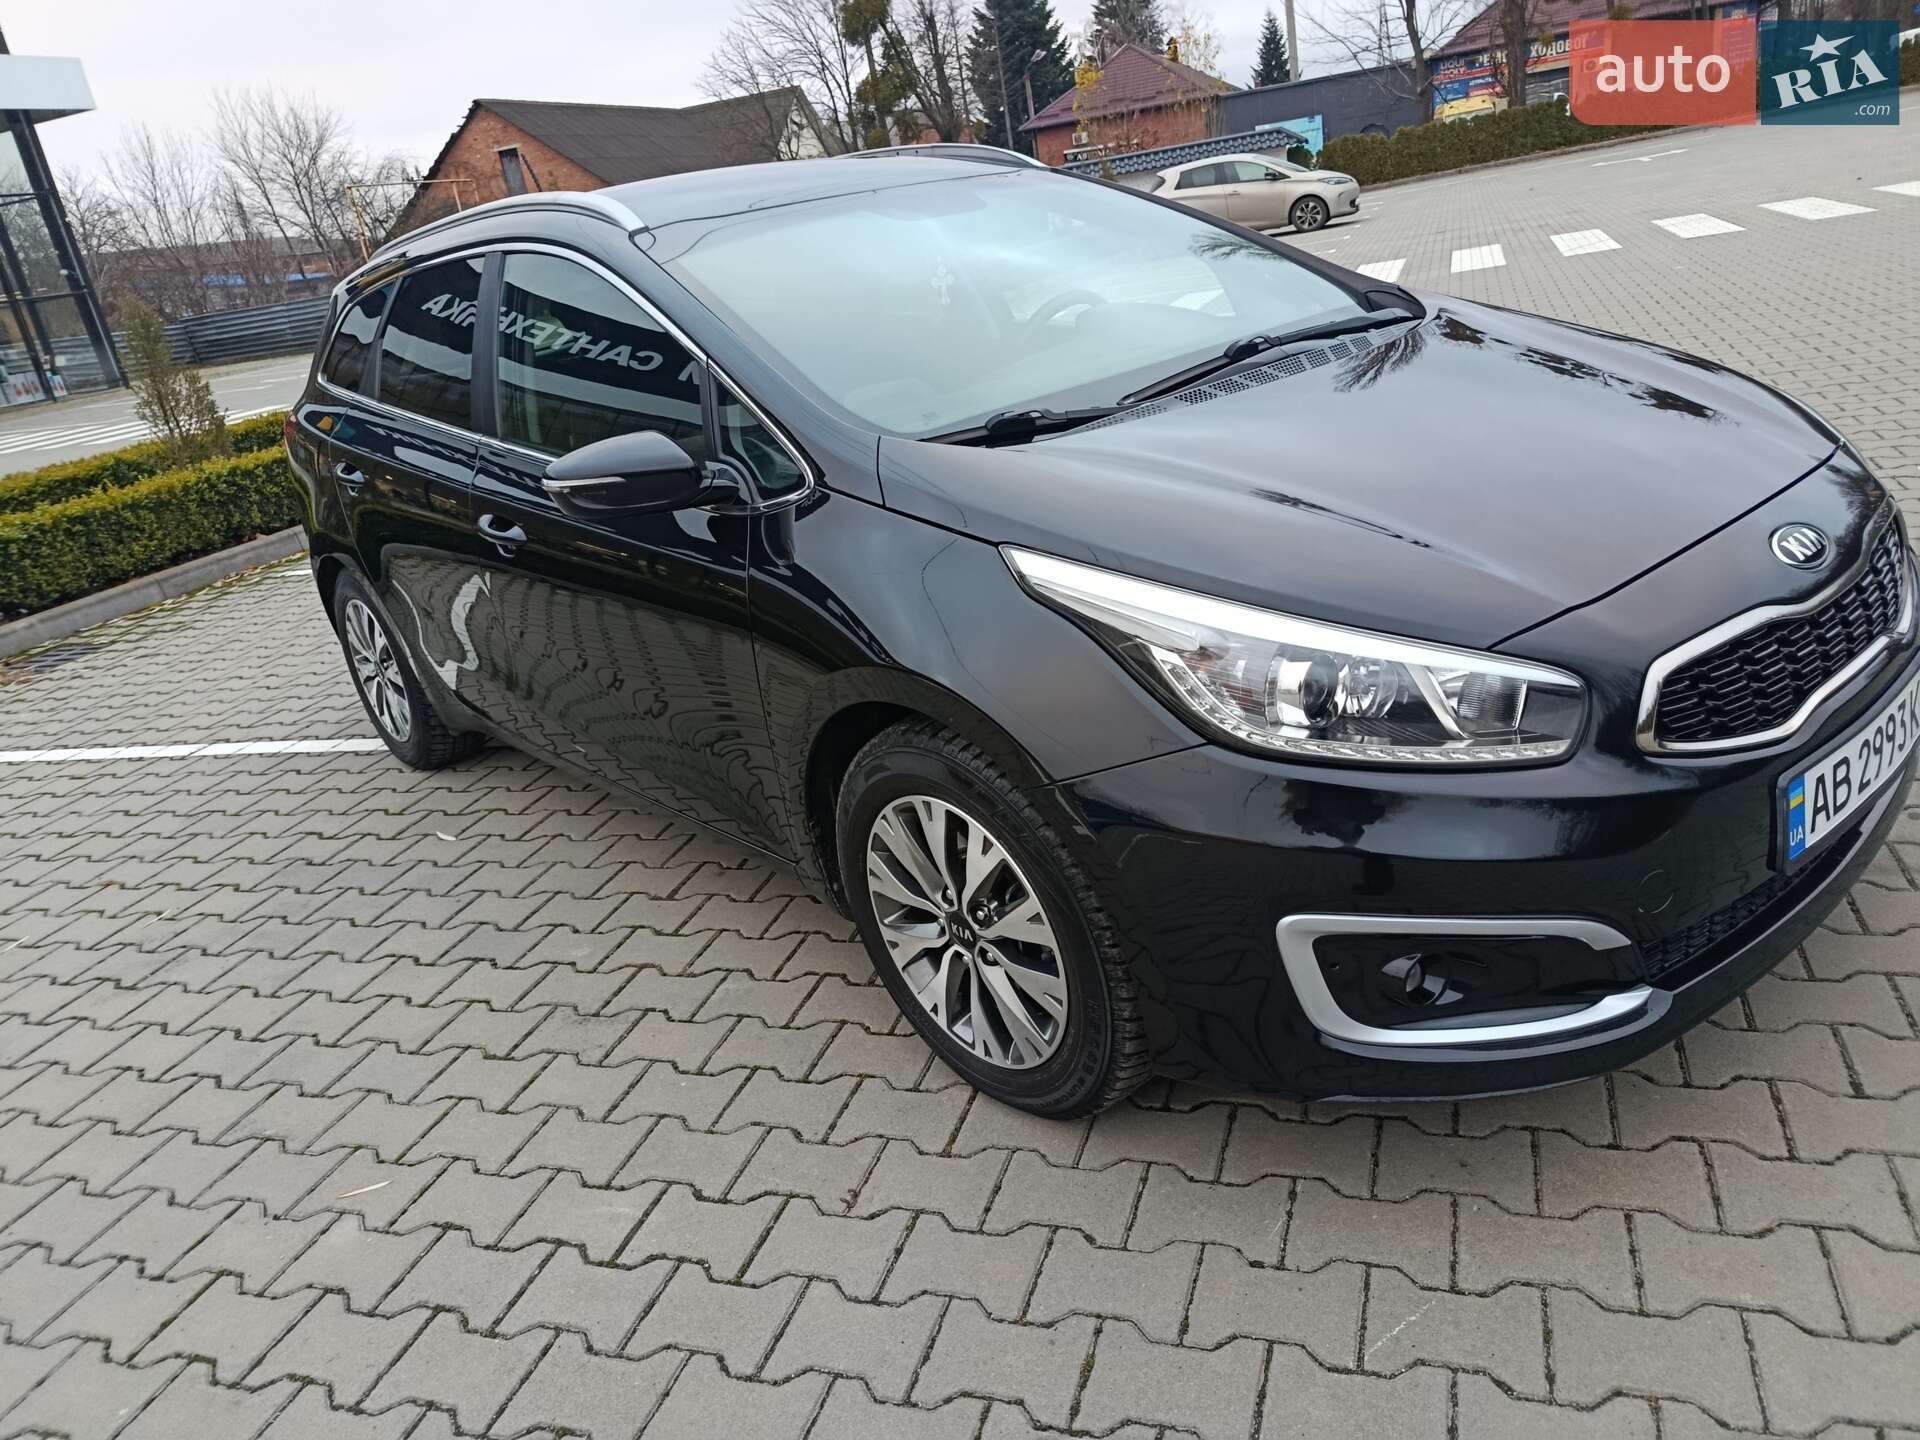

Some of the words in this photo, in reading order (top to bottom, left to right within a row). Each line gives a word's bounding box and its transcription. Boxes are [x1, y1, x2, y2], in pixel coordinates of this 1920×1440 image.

[1780, 528, 1826, 560] KIA
[1810, 755, 1852, 834] AB
[1858, 699, 1907, 795] 2993
[1789, 825, 1804, 847] UA
[951, 921, 974, 941] KIA
